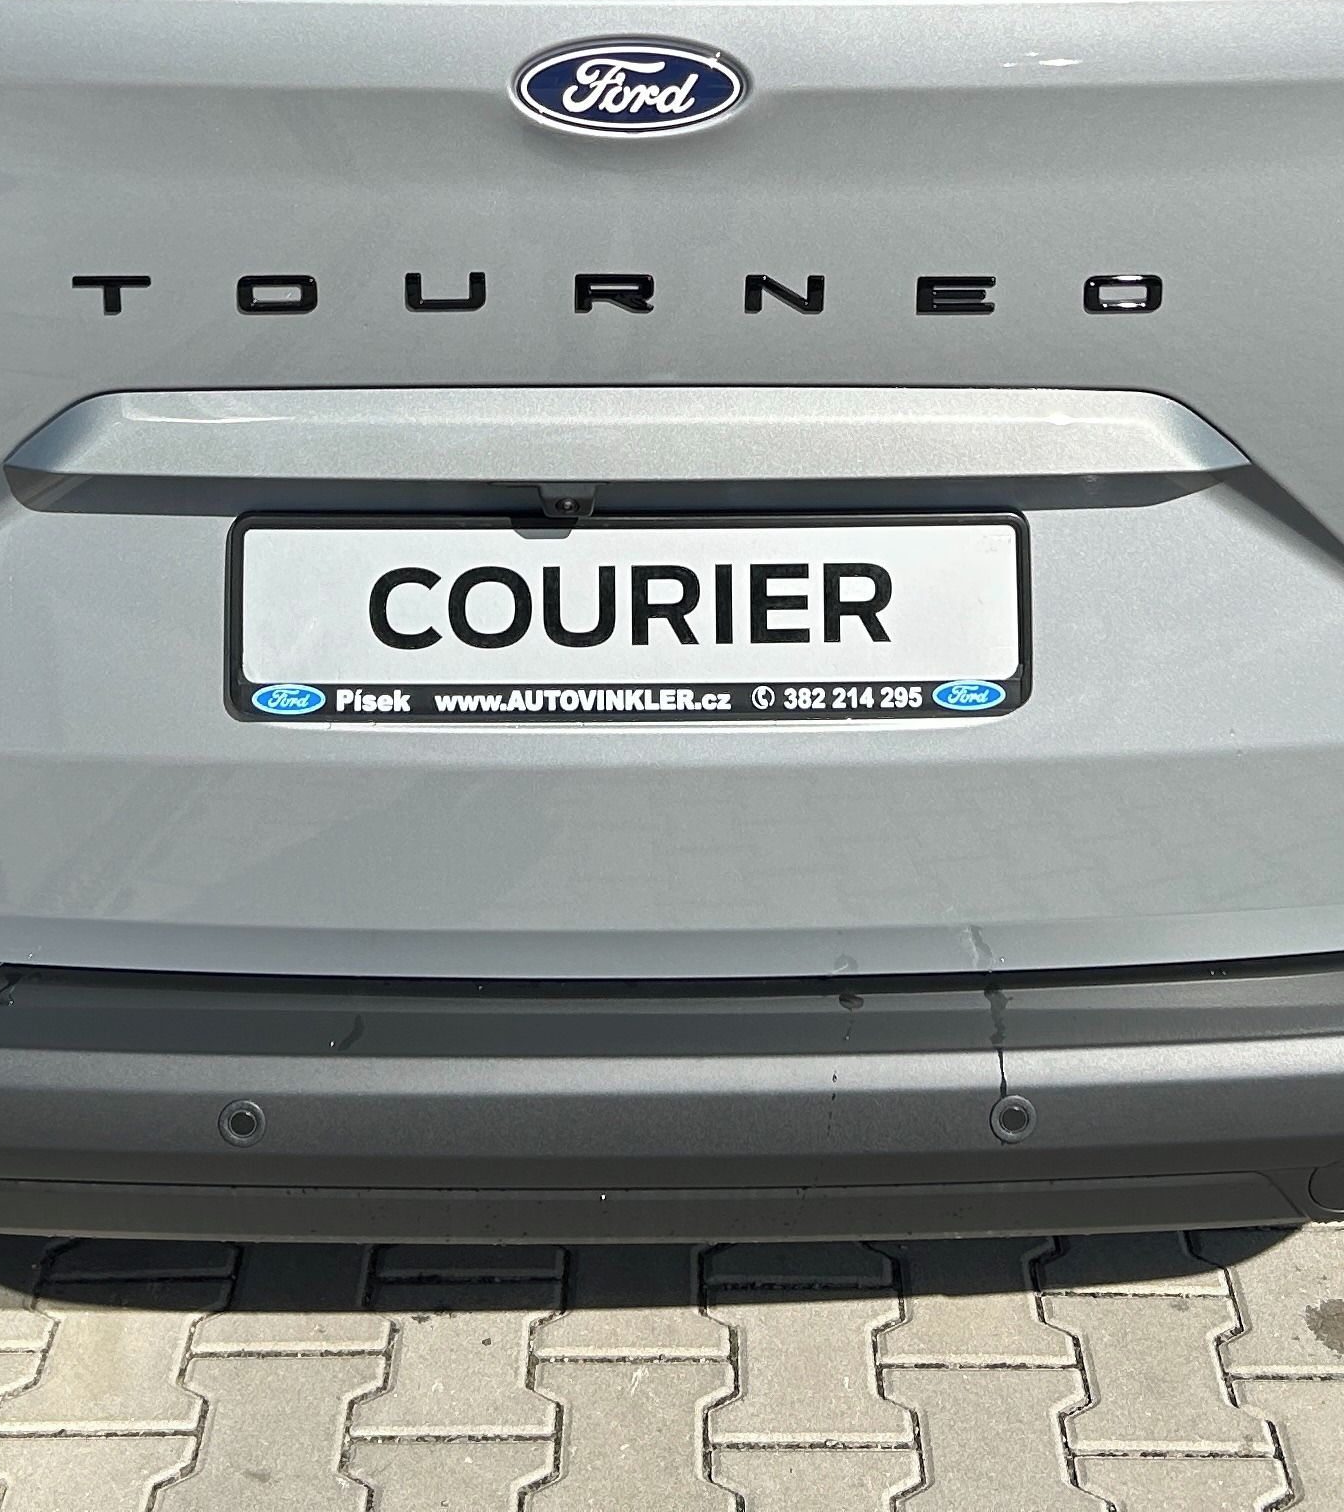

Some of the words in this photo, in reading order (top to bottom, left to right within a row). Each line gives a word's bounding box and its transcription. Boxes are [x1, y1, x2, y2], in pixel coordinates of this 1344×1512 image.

[562, 58, 699, 113] Ford
[72, 271, 1164, 316] TOURNEO
[368, 562, 894, 650] COURIER
[267, 688, 309, 709] Ford
[336, 688, 411, 712] Písek
[434, 689, 732, 712] www.AUTOVINKLER.cz
[783, 687, 825, 710] 382
[832, 687, 875, 709] 214
[880, 686, 923, 709] 295
[947, 686, 990, 705] Ford
